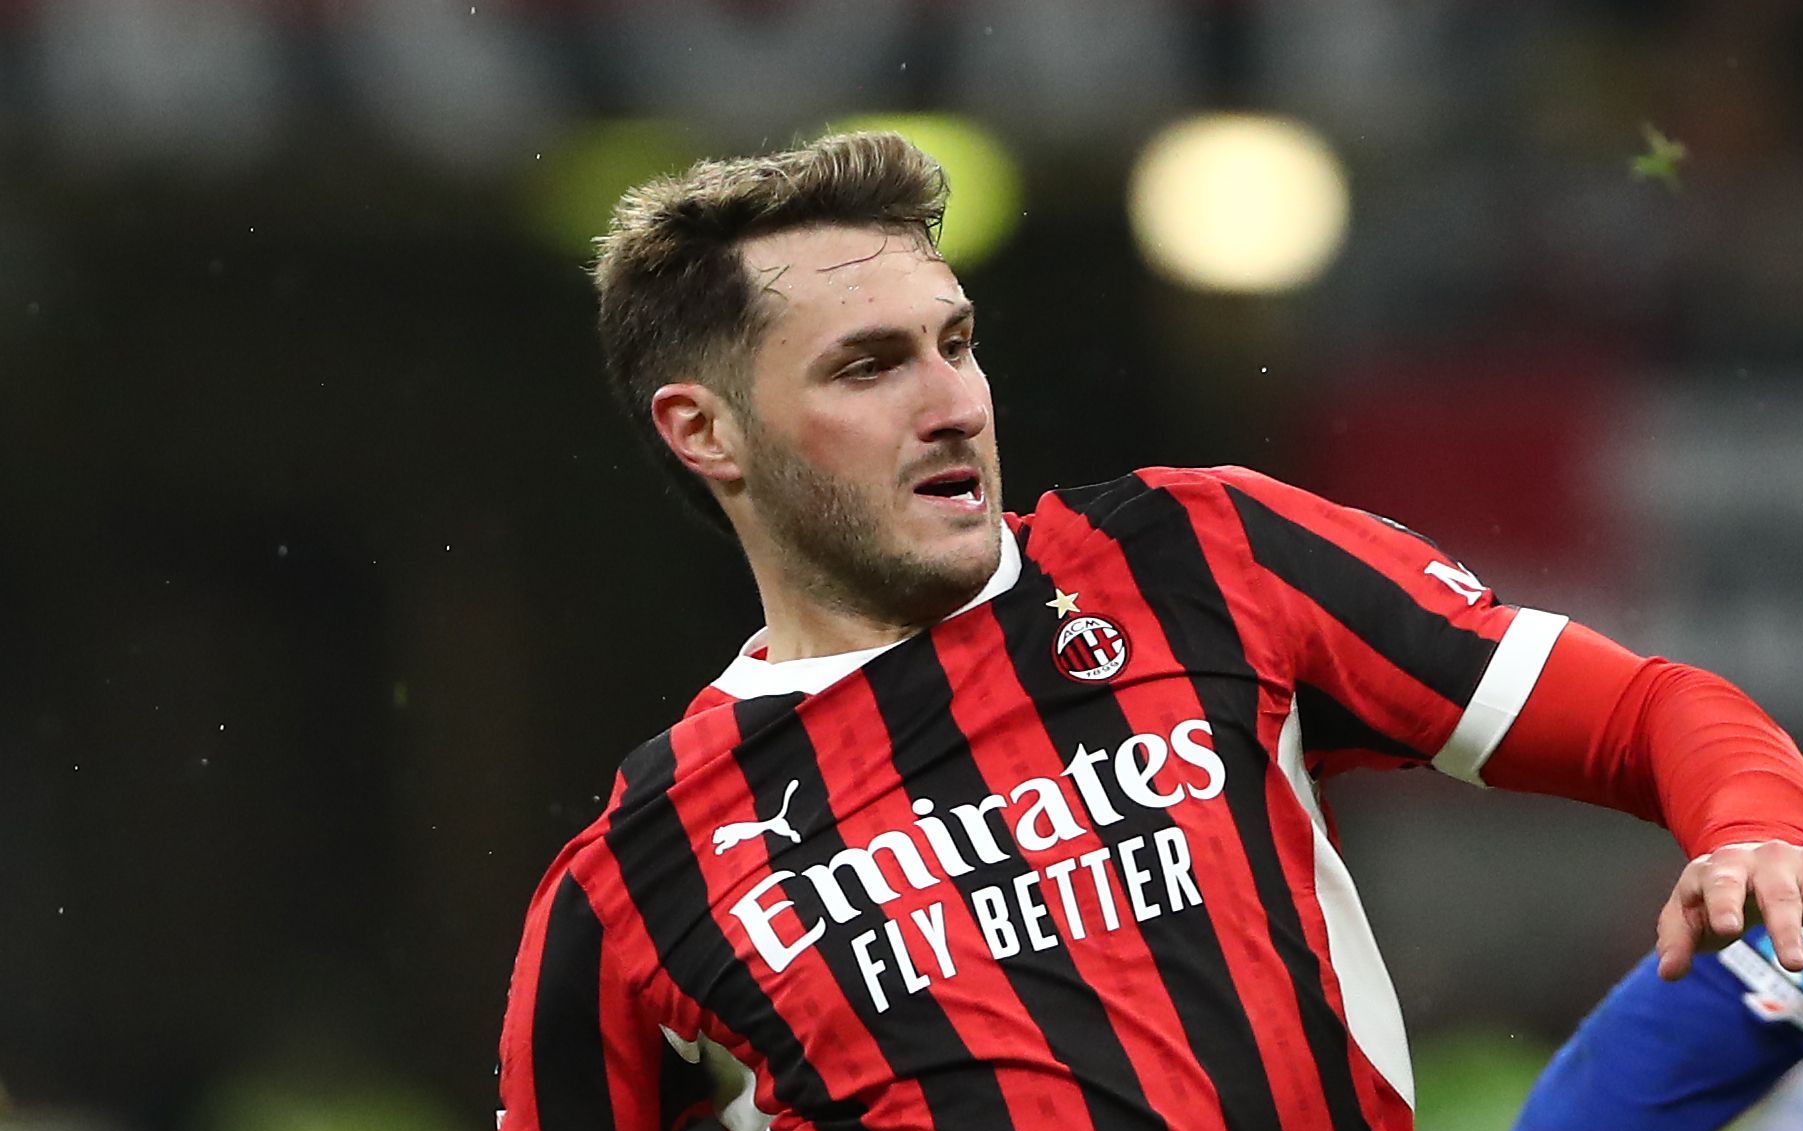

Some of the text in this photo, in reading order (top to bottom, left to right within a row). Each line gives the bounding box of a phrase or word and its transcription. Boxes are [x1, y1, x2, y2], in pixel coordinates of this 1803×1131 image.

[1062, 619, 1101, 645] ACM
[729, 718, 1227, 973] Emirates
[850, 826, 1204, 1013] FLY BETTER
